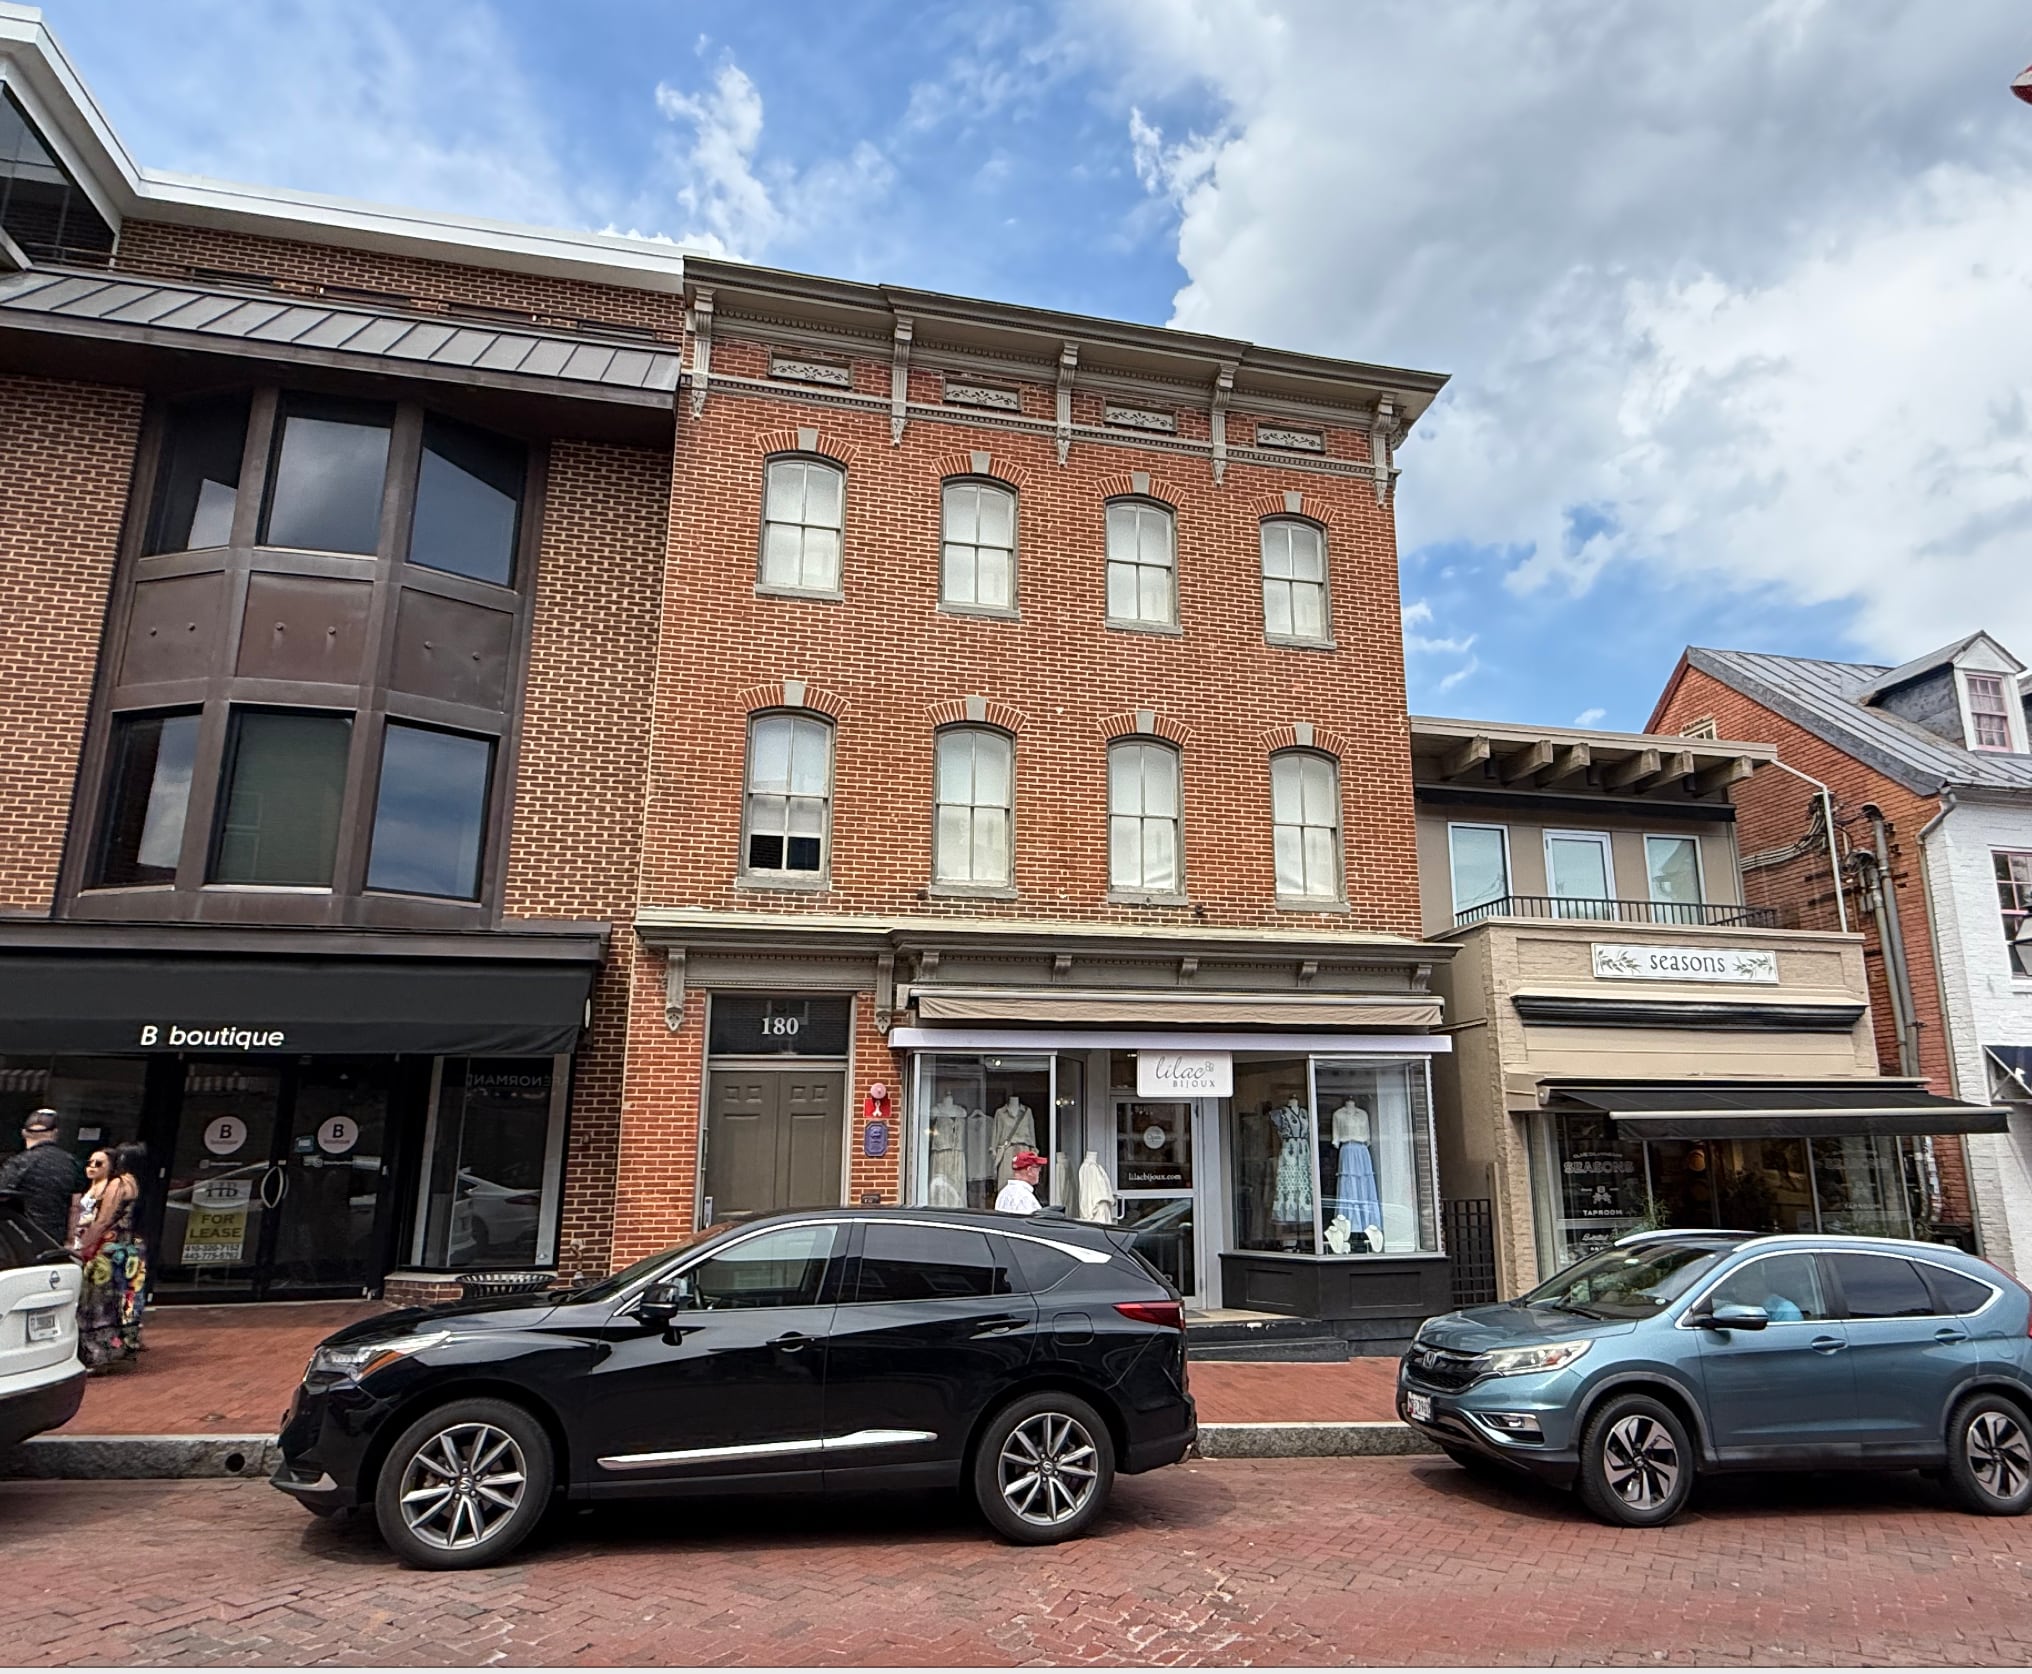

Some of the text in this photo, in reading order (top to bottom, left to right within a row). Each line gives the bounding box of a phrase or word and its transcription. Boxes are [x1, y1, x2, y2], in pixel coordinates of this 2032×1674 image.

[1650, 954, 1726, 973] seasons
[761, 1017, 799, 1035] 180
[140, 1025, 285, 1051] B boutique
[1155, 1055, 1206, 1079] lilac
[1172, 1079, 1216, 1088] BIJOUX
[219, 1124, 233, 1139] B
[332, 1123, 345, 1138] B
[200, 1214, 235, 1225] FOR
[1582, 1209, 1623, 1217] TAPROOM
[189, 1227, 242, 1239] LEASE
